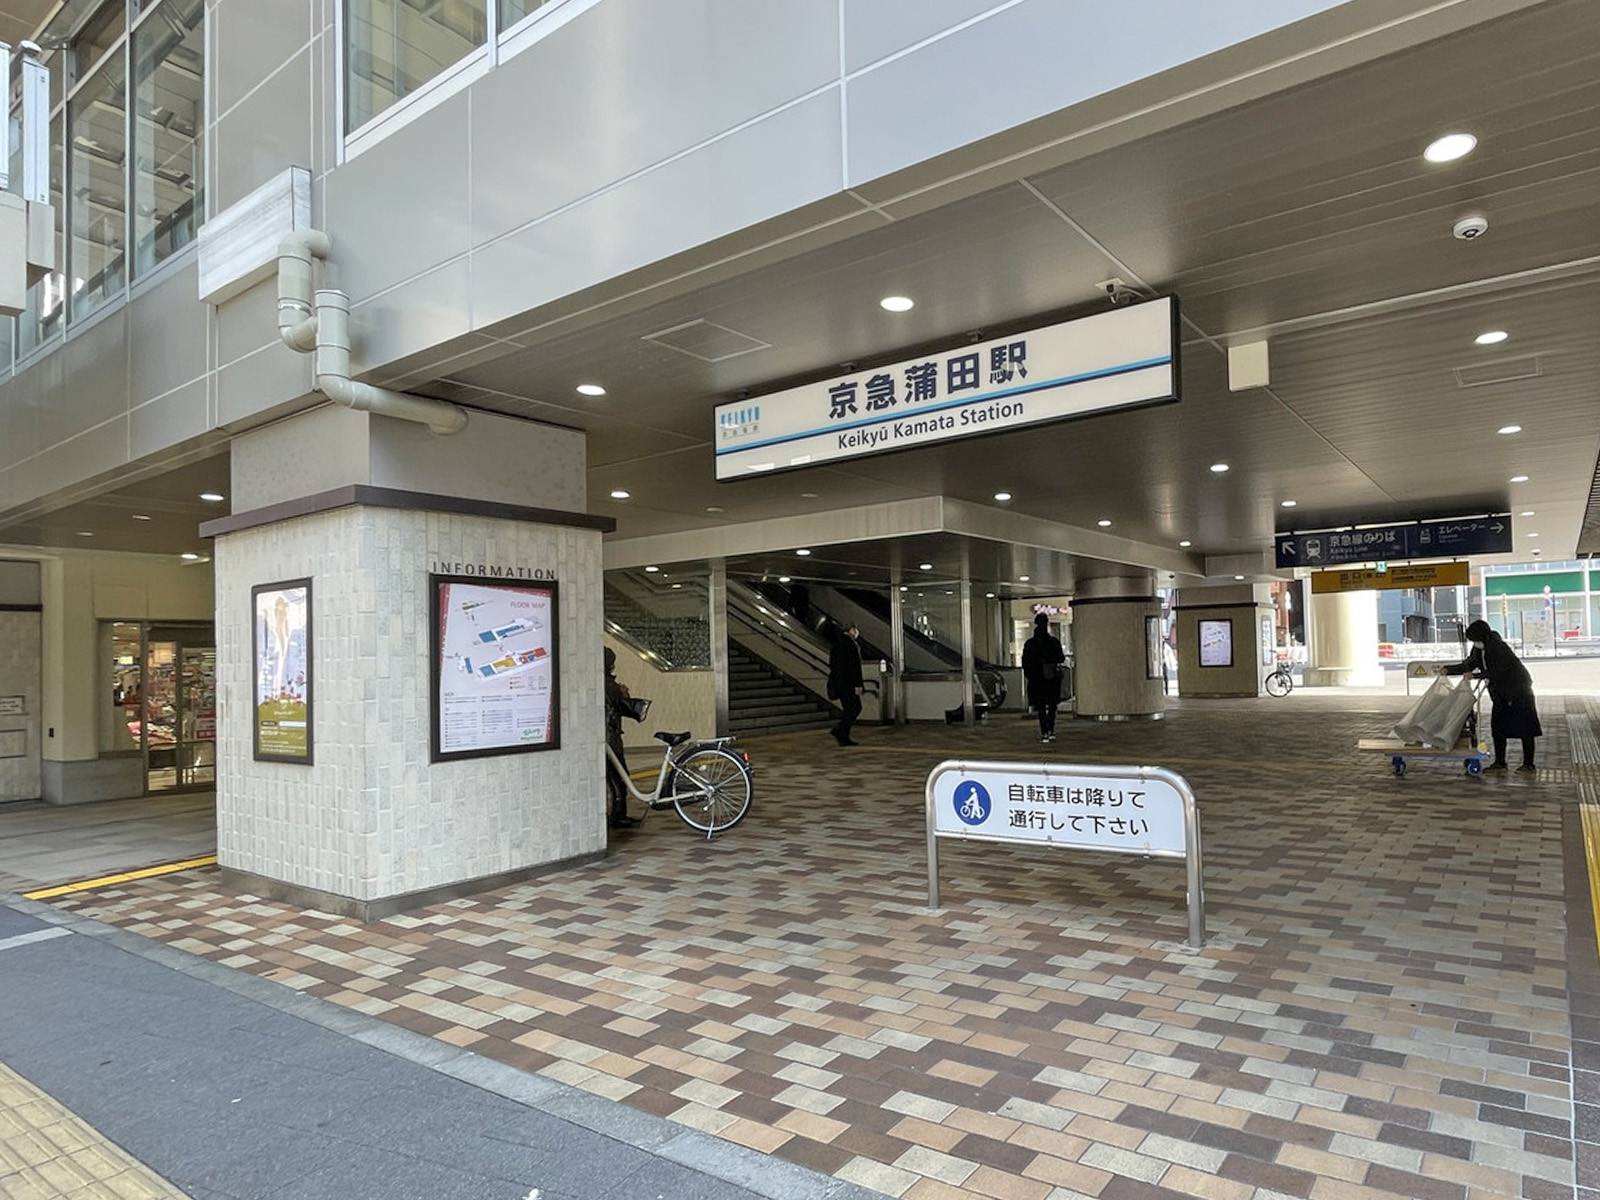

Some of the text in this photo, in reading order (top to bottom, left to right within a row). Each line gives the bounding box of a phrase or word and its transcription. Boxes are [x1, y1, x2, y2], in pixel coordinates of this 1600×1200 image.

[828, 340, 1029, 419] 京急蒲田駅
[893, 415, 956, 438] Kamata
[960, 402, 1024, 425] Station
[433, 561, 555, 580] INFORMATION
[1007, 784, 1147, 809] 自転車は降りて
[1009, 810, 1149, 836] 通行して下さい
